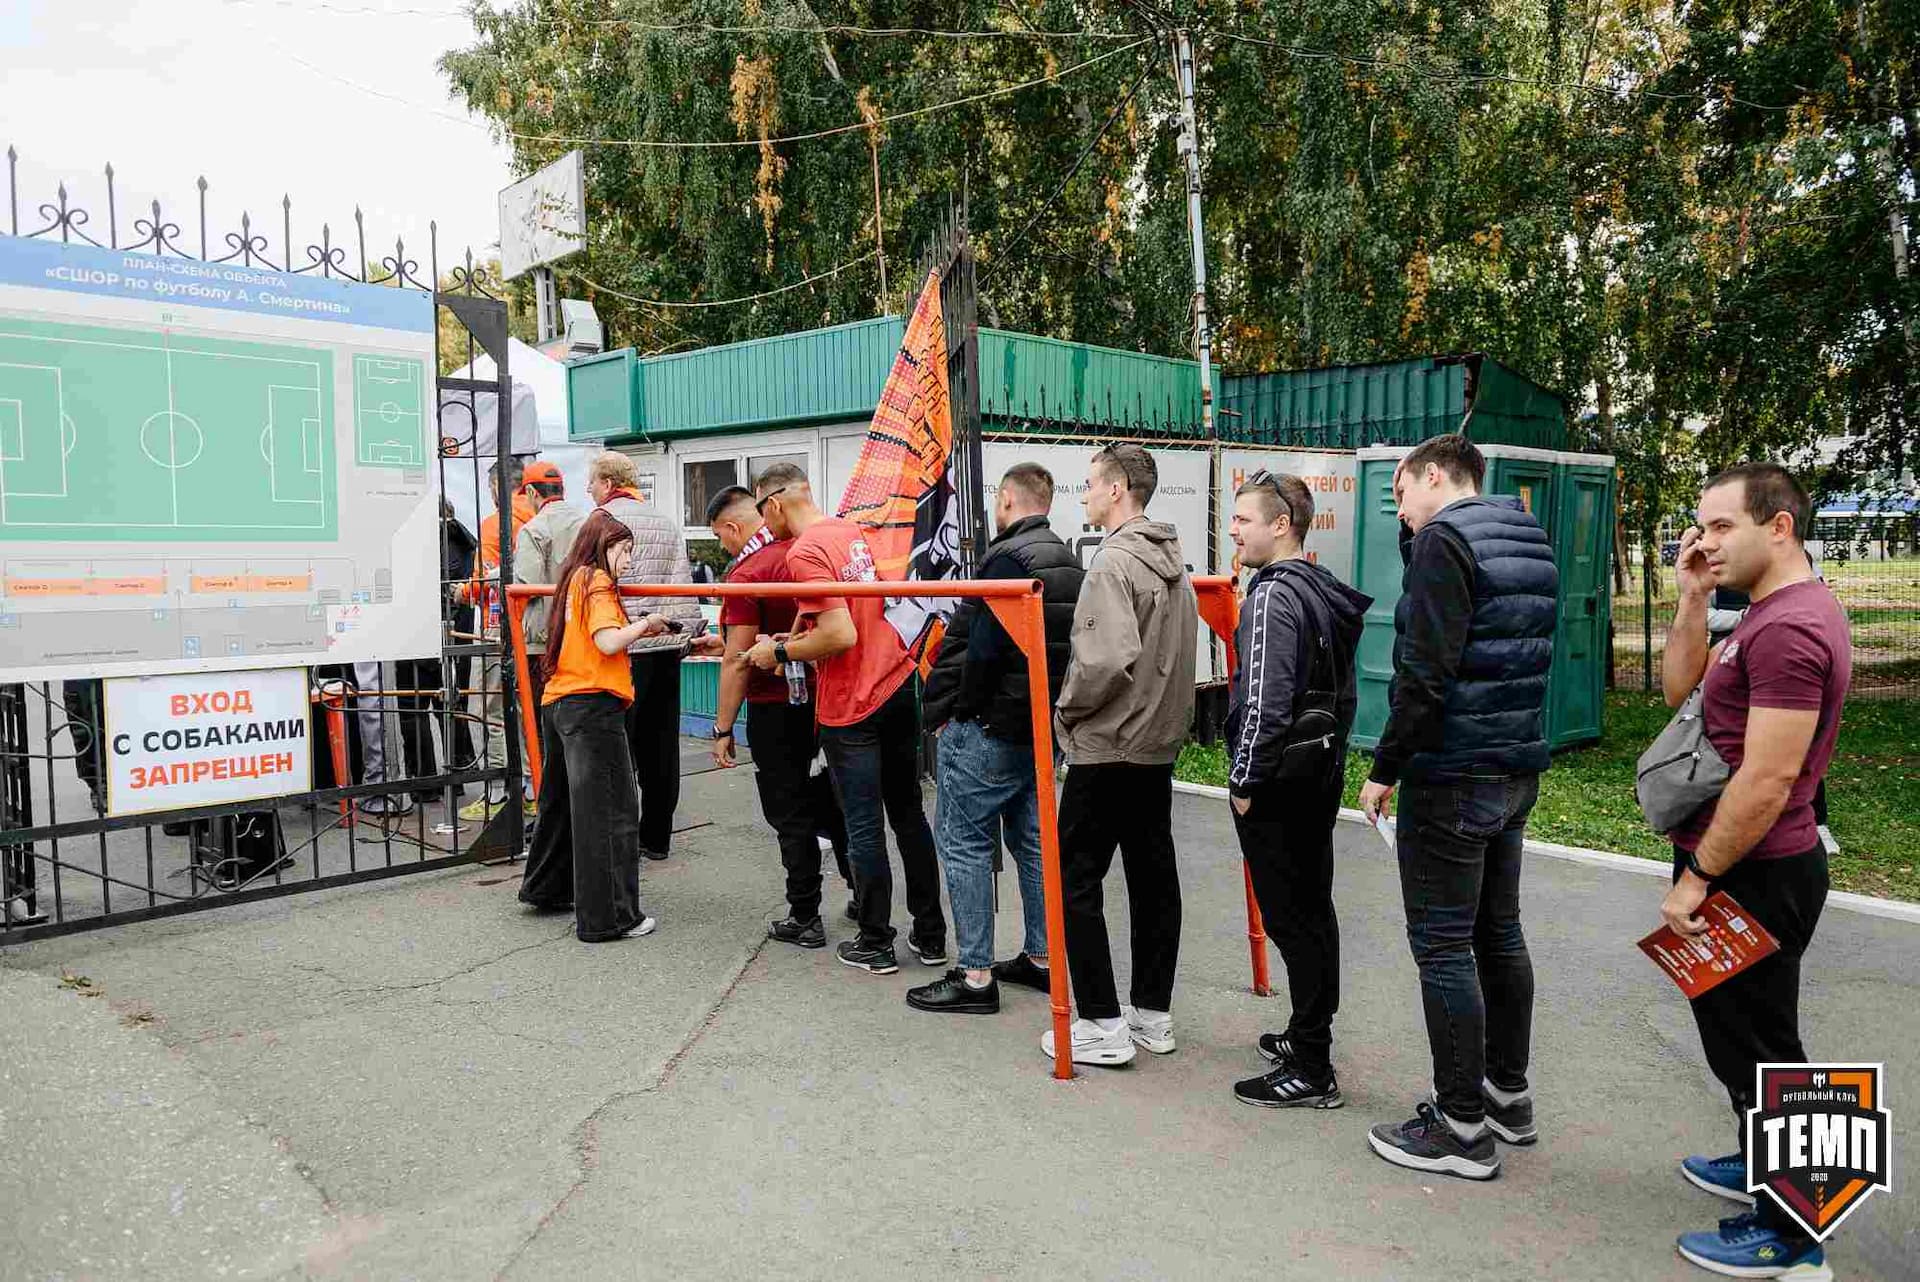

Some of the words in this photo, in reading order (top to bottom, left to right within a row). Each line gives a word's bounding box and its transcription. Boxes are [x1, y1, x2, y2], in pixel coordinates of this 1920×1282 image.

[45, 266, 119, 286] «СШОР
[124, 277, 149, 290] по
[153, 278, 232, 302] футболу
[237, 288, 254, 303] А.
[259, 291, 351, 314] Смертина»
[123, 256, 221, 279] ПЛАН-СХЕМА
[223, 270, 288, 288] ОБЪЕКТА
[170, 689, 253, 716] ВХОД
[113, 733, 131, 756] С
[143, 718, 305, 753] СОБАКАМИ
[129, 752, 293, 790] ЗАПРЕЩЕН
